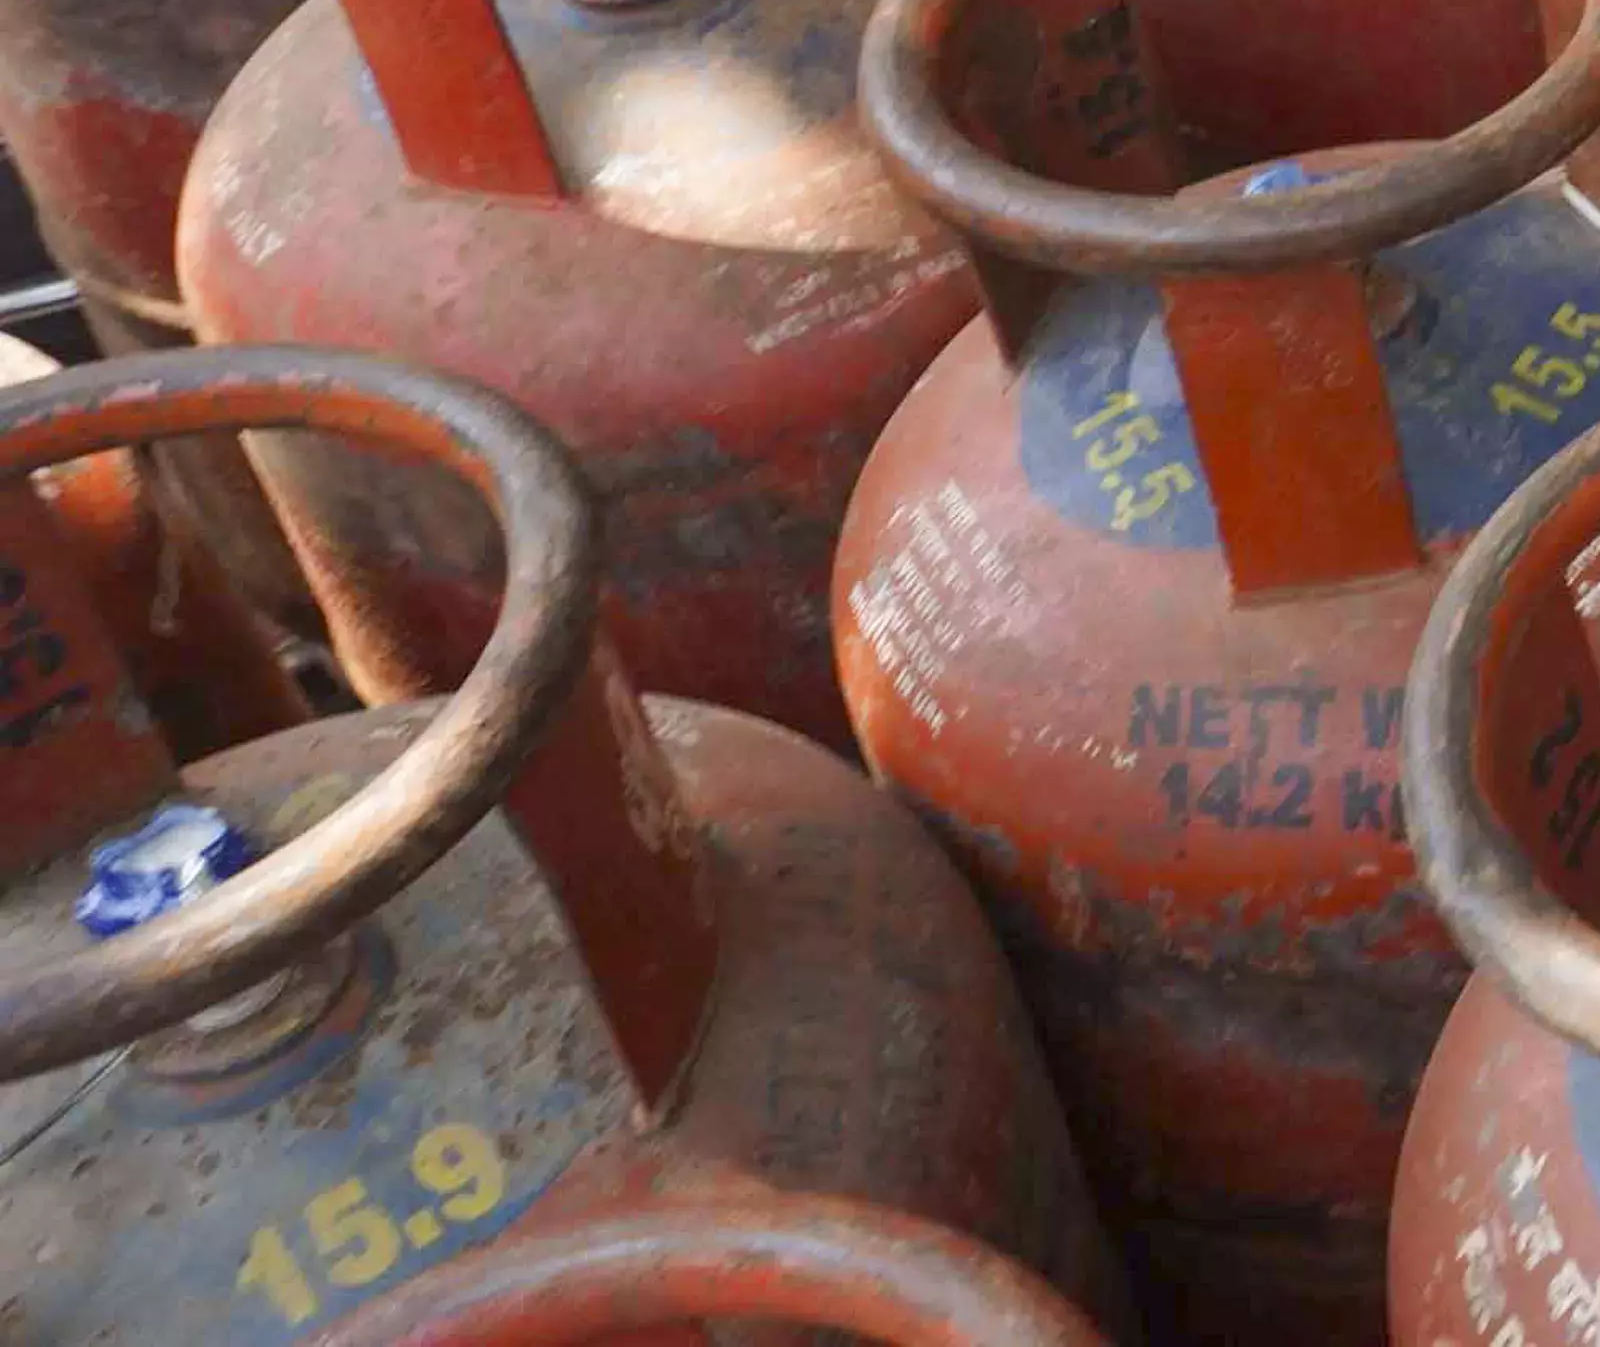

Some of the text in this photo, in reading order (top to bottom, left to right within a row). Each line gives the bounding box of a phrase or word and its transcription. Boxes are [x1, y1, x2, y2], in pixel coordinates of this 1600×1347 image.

[1069, 389, 1196, 531] 15.5
[1127, 682, 1408, 750] NETT W
[1158, 761, 1315, 830] 14.2
[236, 1121, 507, 1328] 15.9
